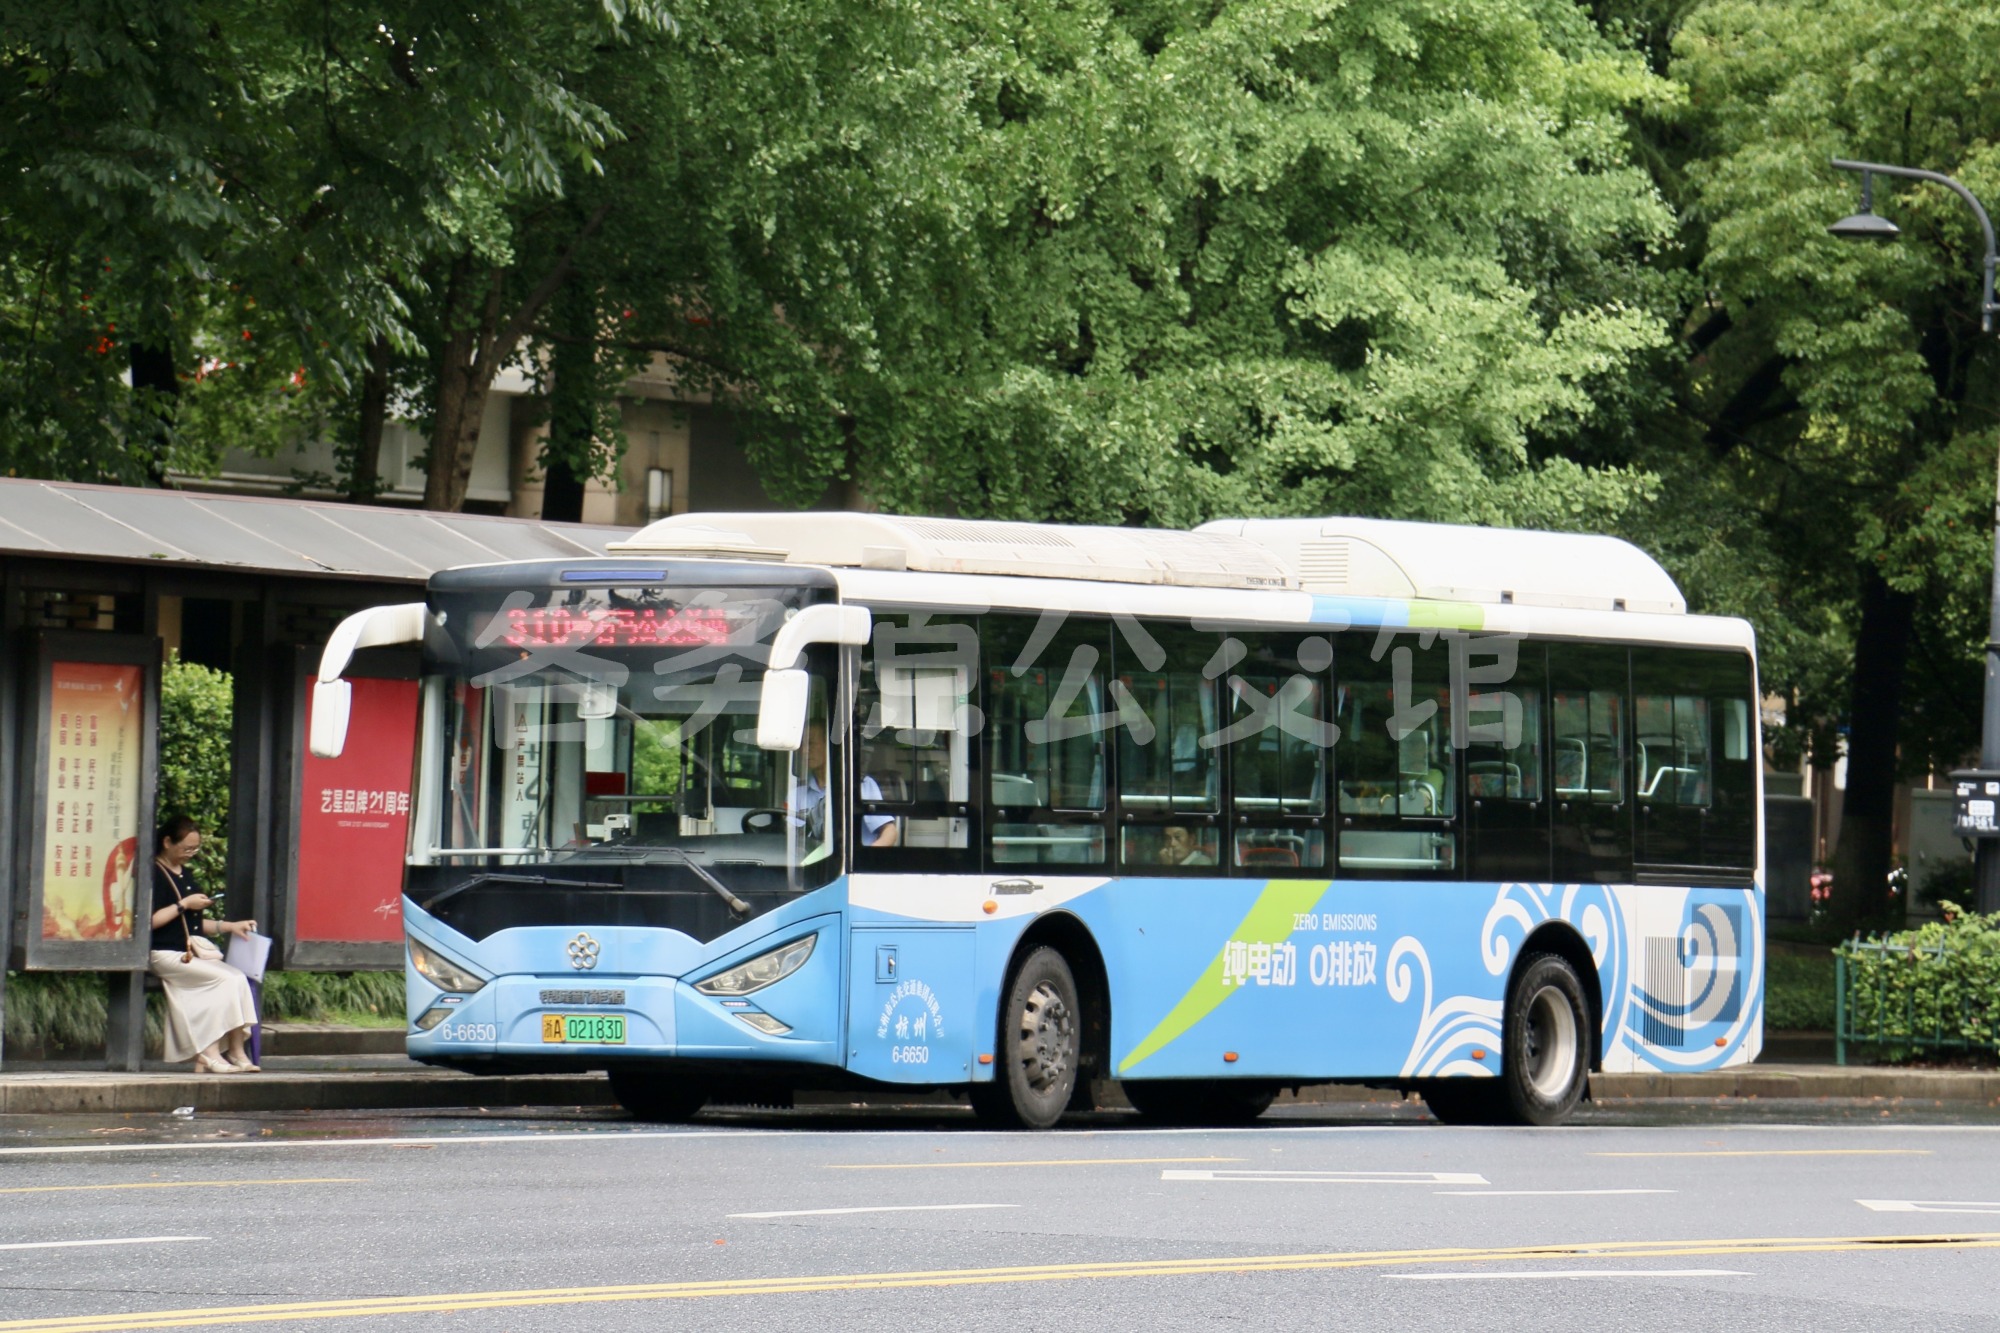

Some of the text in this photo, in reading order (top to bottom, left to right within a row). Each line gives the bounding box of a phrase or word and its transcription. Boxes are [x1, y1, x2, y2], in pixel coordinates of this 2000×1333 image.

[320, 788, 410, 816] 艺星品牌21周年
[1293, 914, 1377, 931] ZERO EMISSIONS
[1222, 941, 1377, 986] 纯电动 0排放
[442, 1023, 497, 1042] 6-6650
[895, 1011, 927, 1042] 杭州
[892, 1045, 929, 1064] 6-6650
